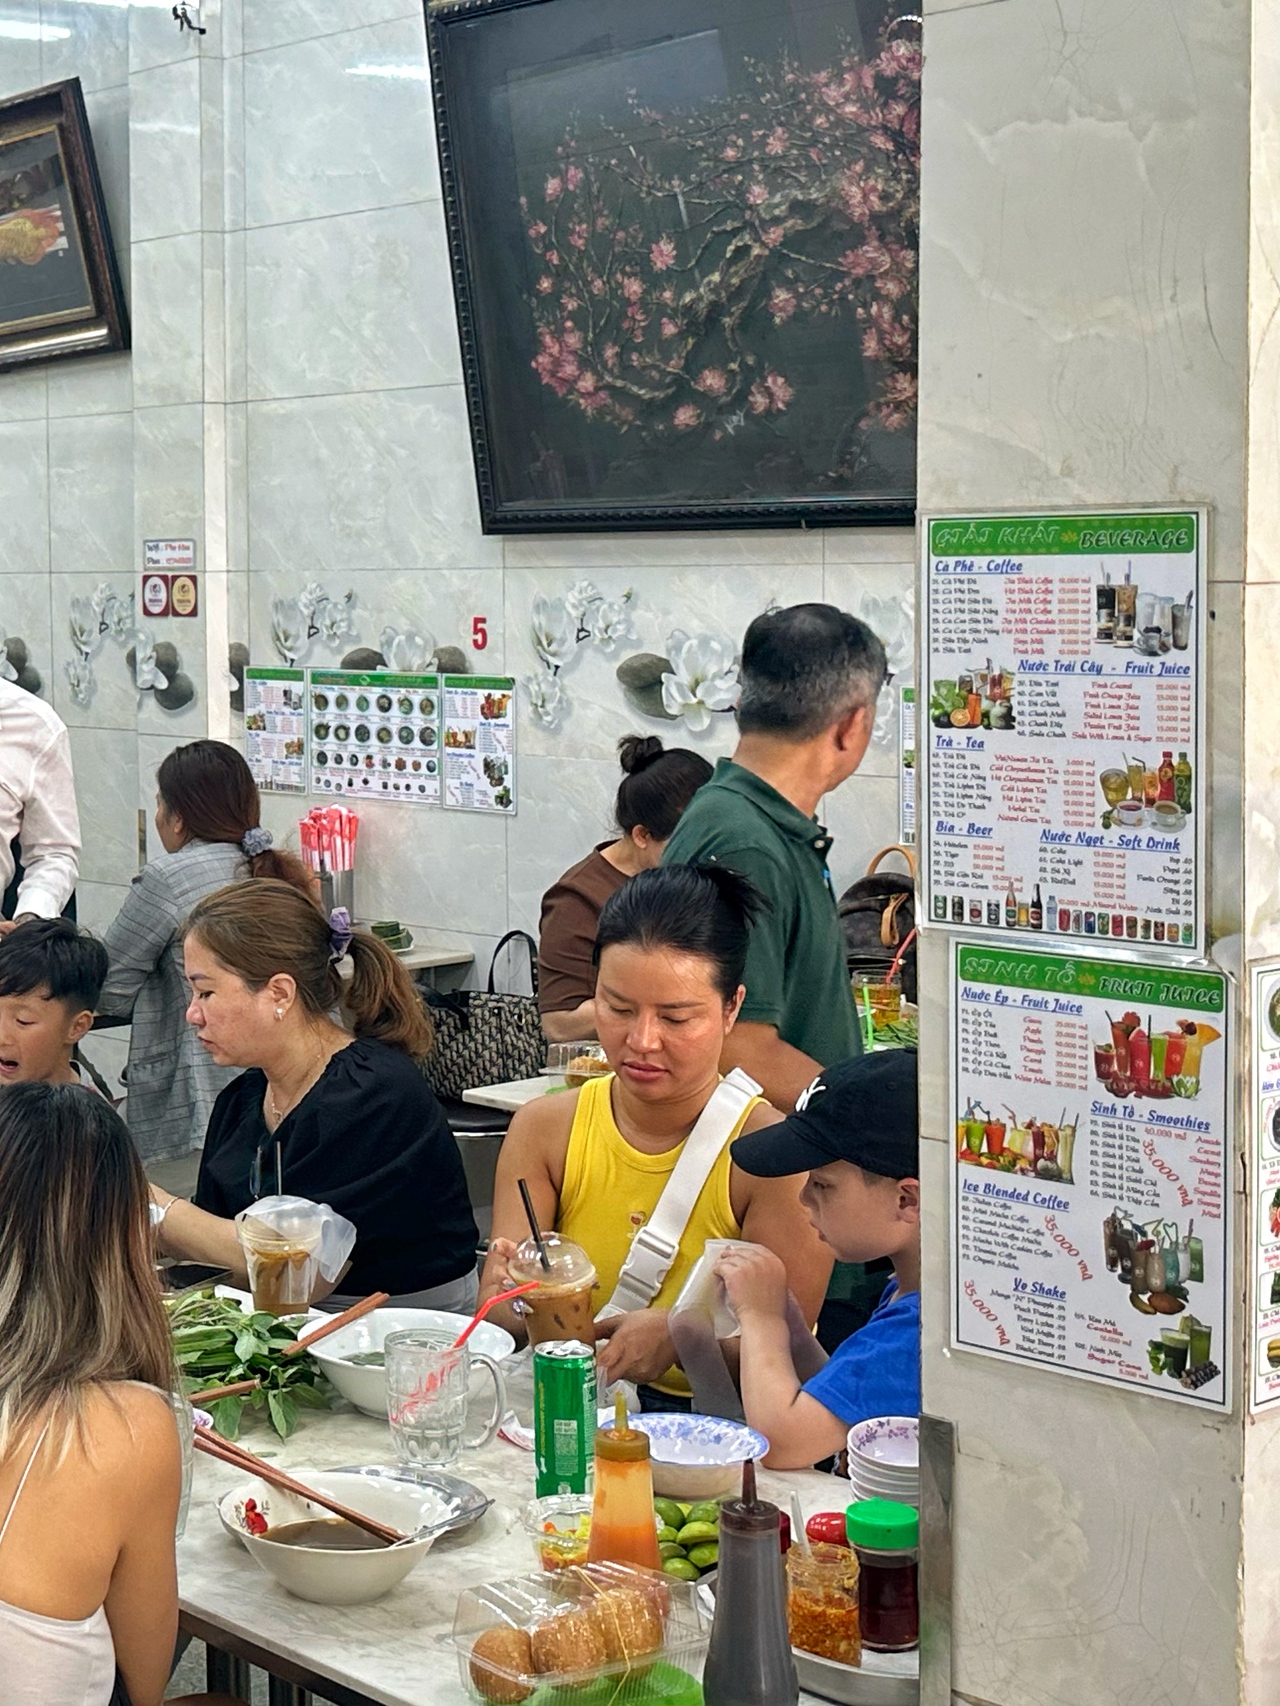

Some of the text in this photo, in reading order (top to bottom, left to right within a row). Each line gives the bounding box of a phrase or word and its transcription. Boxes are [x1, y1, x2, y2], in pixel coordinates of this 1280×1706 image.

[1080, 529, 1188, 548] BEVERAGE
[935, 559, 1023, 574] Cà Phê Coffee
[472, 616, 488, 650] 5
[1018, 659, 1190, 676] Nước Trái Cây Fruit Juice
[936, 735, 985, 749] Trà Tea
[936, 821, 993, 836] Bia Beer
[1040, 829, 1181, 851] Nước Ngọt Soft Drink
[1099, 976, 1220, 1005] FRUIT JUICE
[1021, 995, 1049, 1009] Fruit
[1051, 999, 1083, 1013] Juice
[1091, 1100, 1118, 1115] Sinh
[1147, 1110, 1211, 1130] Smoothies
[1143, 1139, 1180, 1182] 35.000
[963, 1179, 1070, 1210] Ice Blended Coffee
[1044, 1214, 1080, 1257] 35.000
[1013, 1277, 1067, 1299] Yo Shake
[964, 1279, 998, 1322] 35.000
